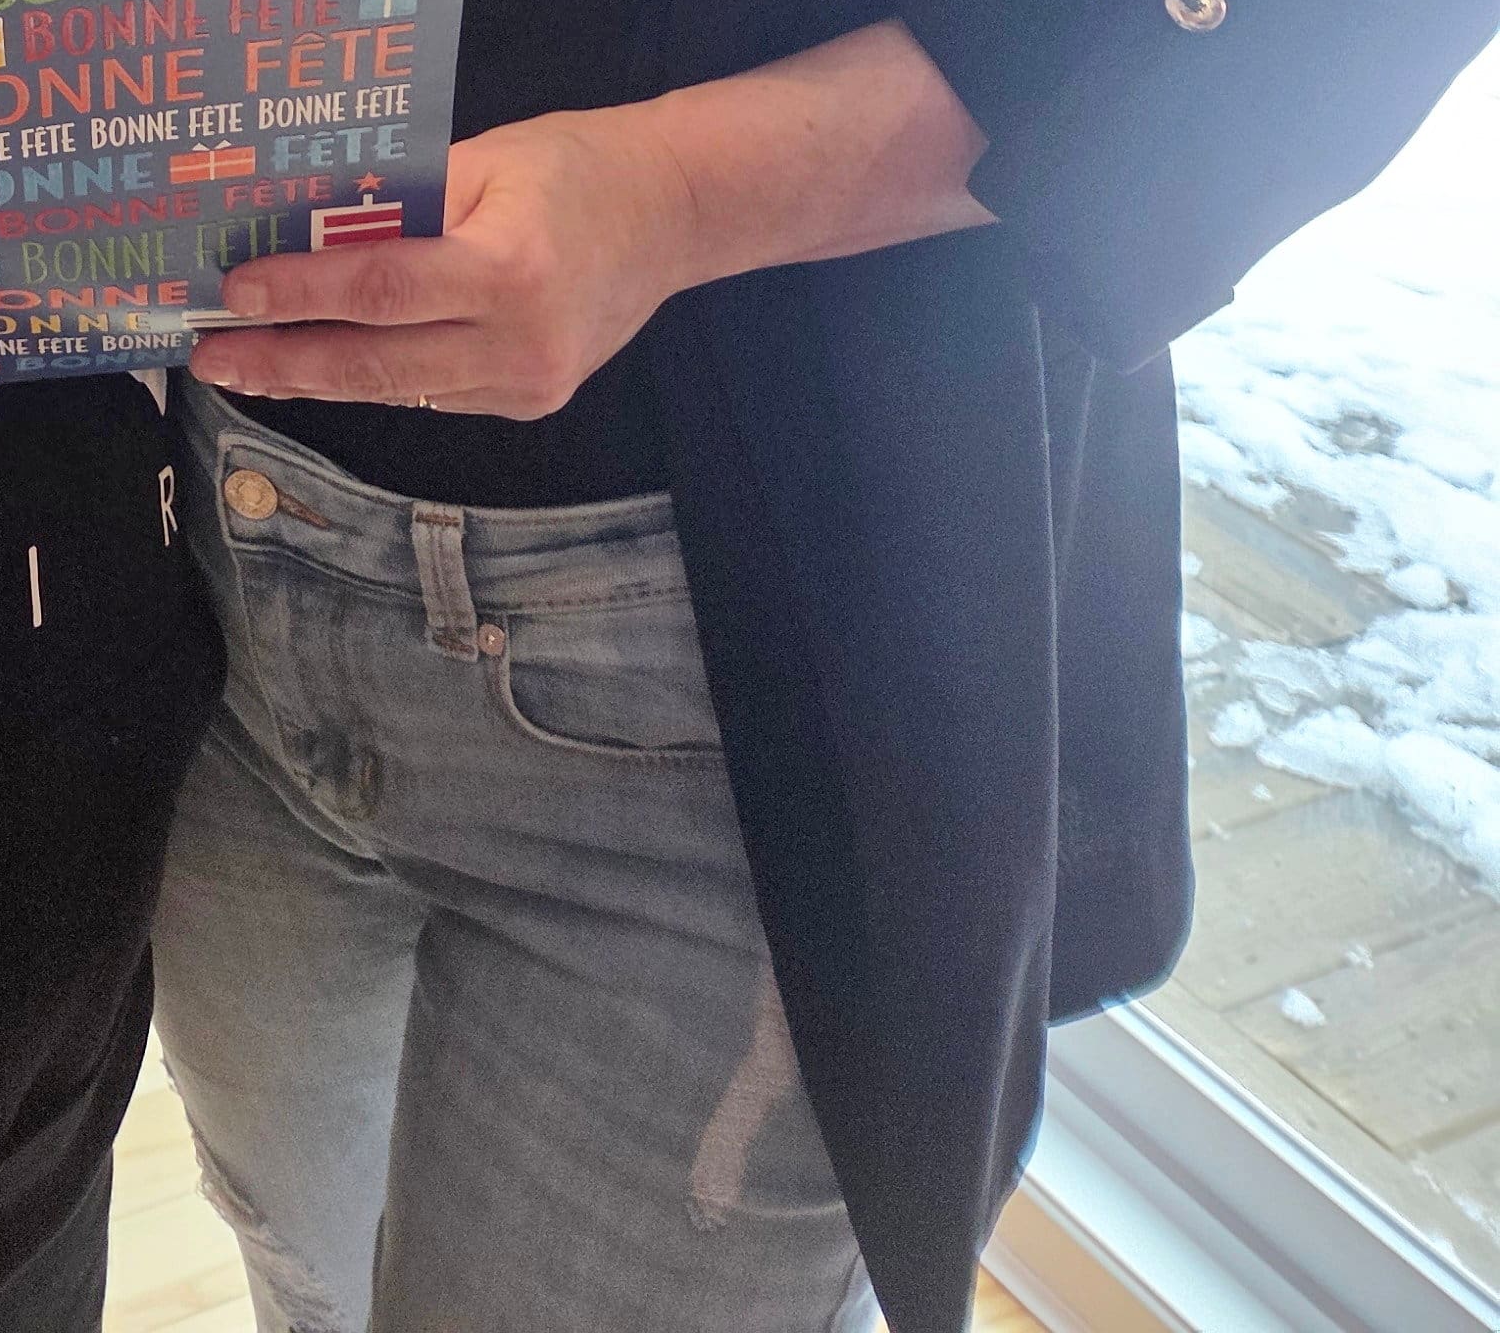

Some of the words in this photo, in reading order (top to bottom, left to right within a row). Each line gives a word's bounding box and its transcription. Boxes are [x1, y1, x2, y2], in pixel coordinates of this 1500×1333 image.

[244, 21, 416, 94] FÊTE
[20, 122, 77, 159] FÊTE
[90, 109, 180, 150] BONNE
[188, 102, 244, 138] FÊTE
[258, 91, 347, 130] BONNE
[355, 83, 412, 119] FÊTE
[21, 225, 179, 285] BONNE
[102, 332, 183, 352] BONNE
